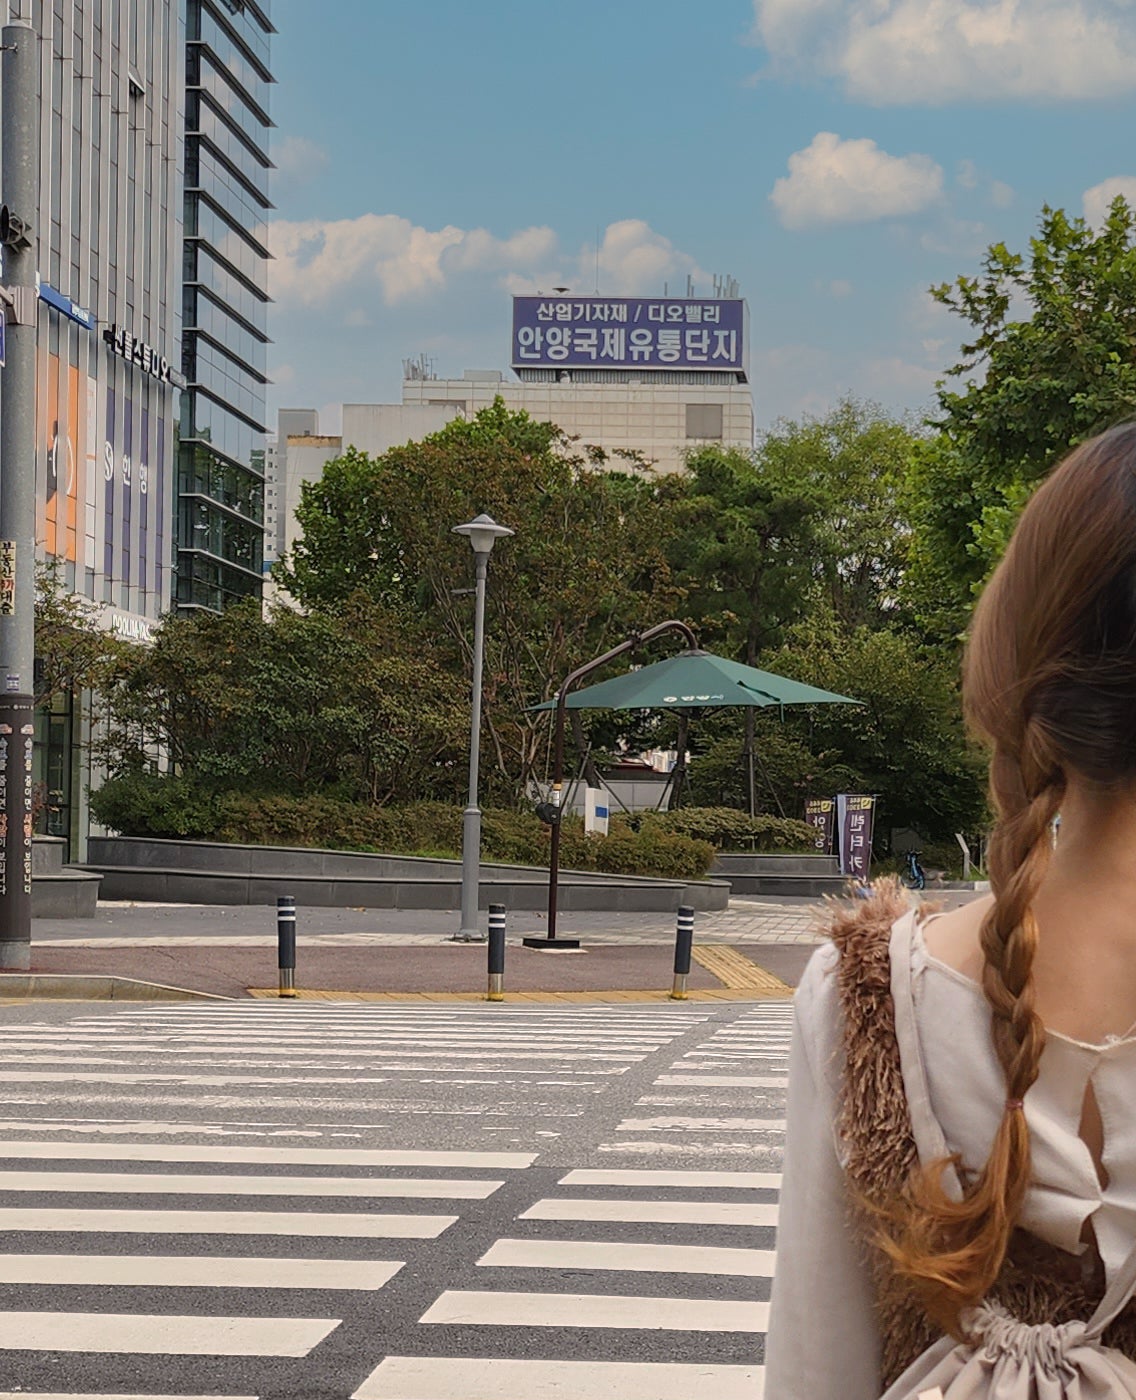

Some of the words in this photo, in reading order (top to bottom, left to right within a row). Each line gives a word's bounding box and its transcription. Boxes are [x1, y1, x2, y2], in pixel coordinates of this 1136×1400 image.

[536, 302, 628, 323] 산업기자재
[648, 304, 720, 324] 디오밸리
[517, 325, 737, 363] 안양국제유통단지
